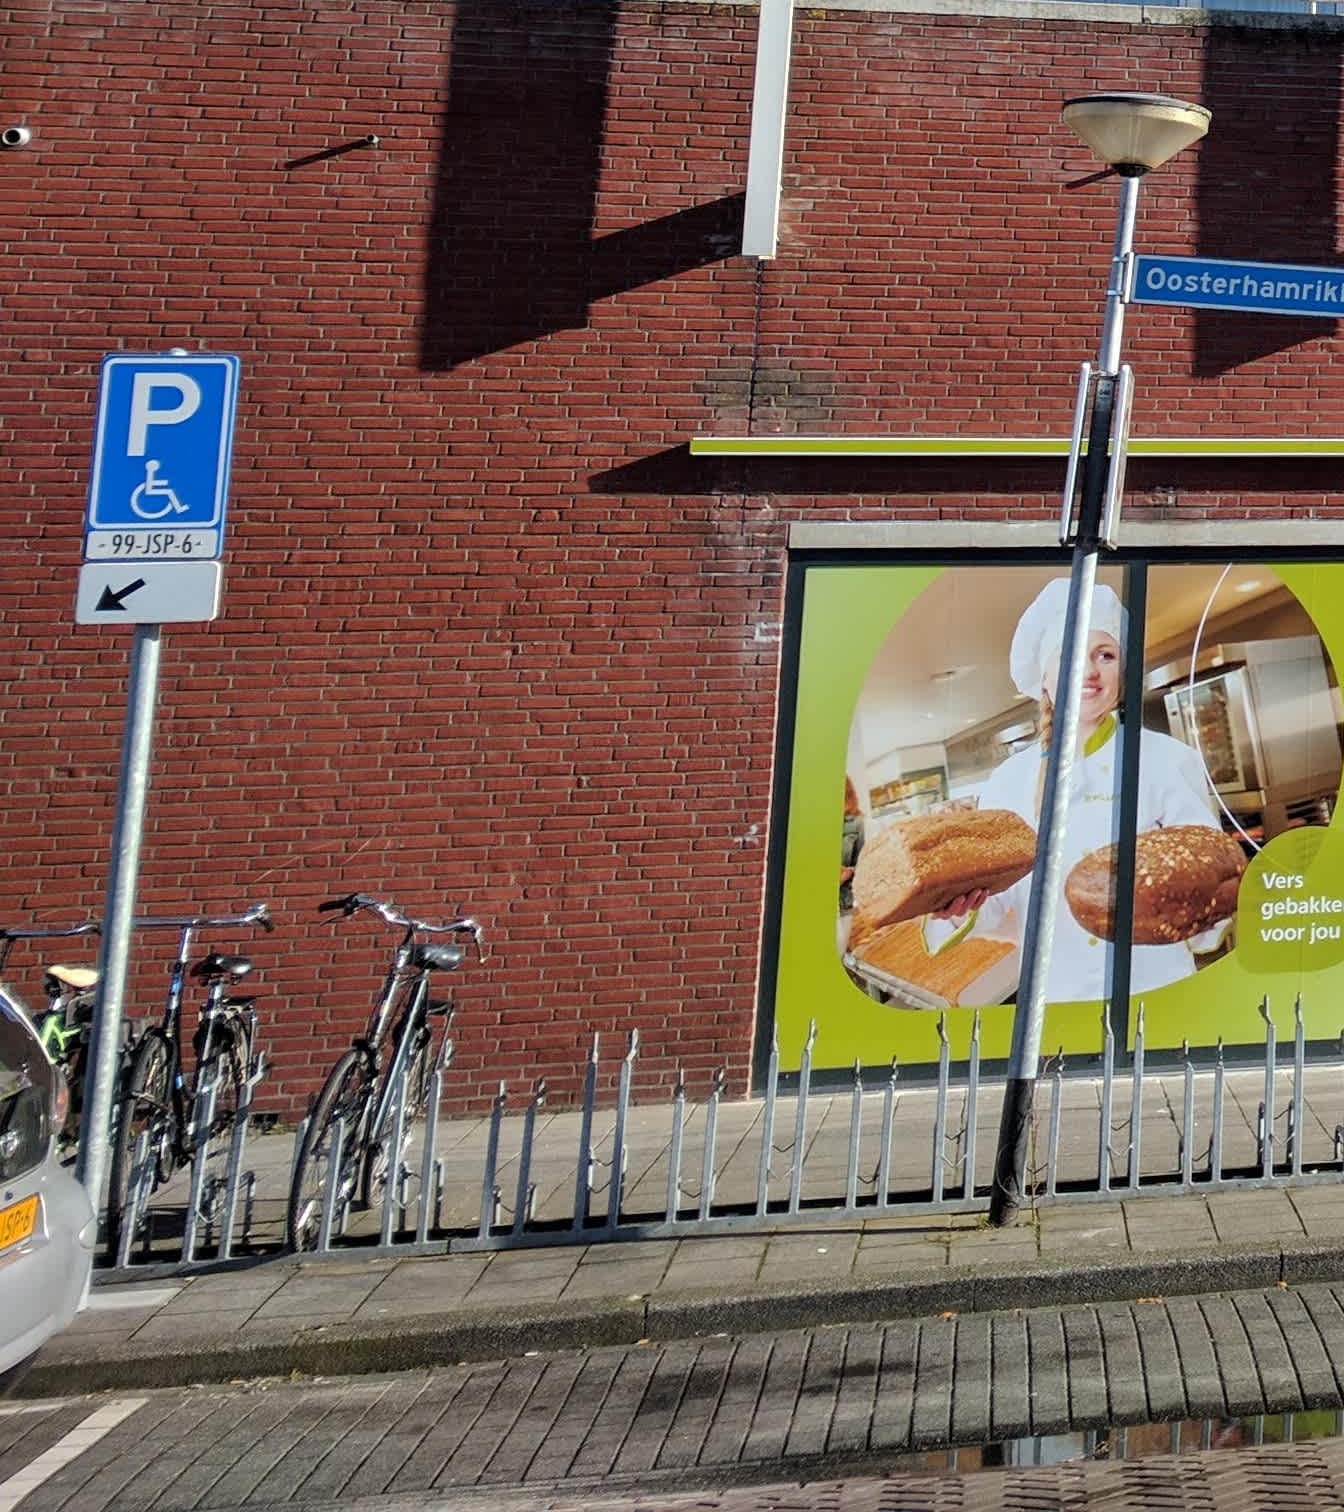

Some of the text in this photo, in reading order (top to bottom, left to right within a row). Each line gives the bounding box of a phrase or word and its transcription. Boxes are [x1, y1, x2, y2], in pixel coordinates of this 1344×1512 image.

[126, 372, 202, 457] P
[112, 533, 193, 555] 99-JSP-6
[1261, 872, 1304, 889] Vers
[1260, 922, 1342, 944] voor jou
